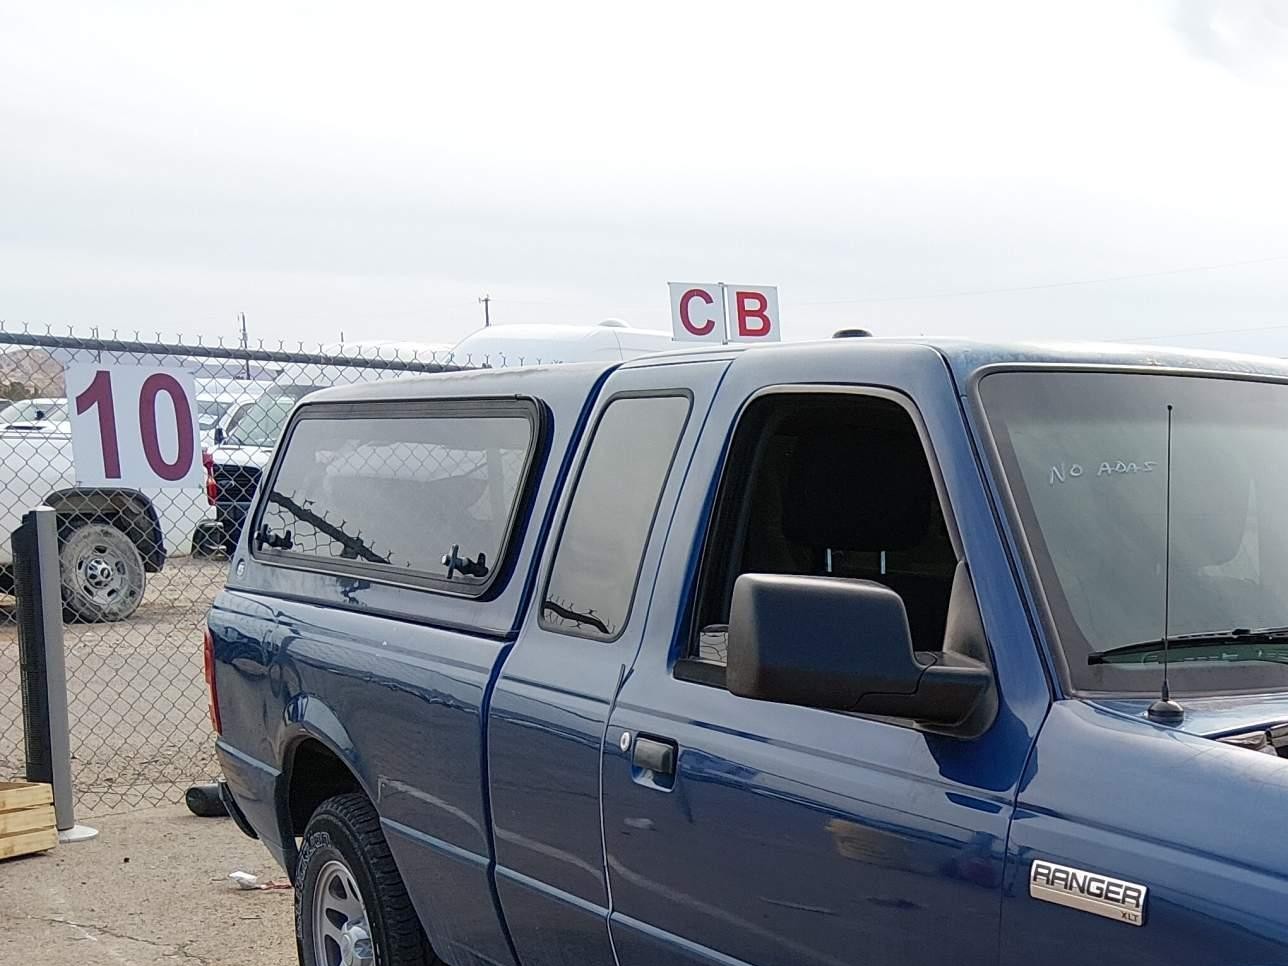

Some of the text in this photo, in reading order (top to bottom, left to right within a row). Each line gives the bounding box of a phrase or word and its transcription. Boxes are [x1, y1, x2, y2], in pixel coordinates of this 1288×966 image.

[679, 288, 716, 336] C
[736, 291, 771, 337] B
[76, 370, 195, 482] 10
[1048, 462, 1083, 485] NO
[1033, 863, 1142, 908] RANGER
[1120, 910, 1139, 922] XLT
